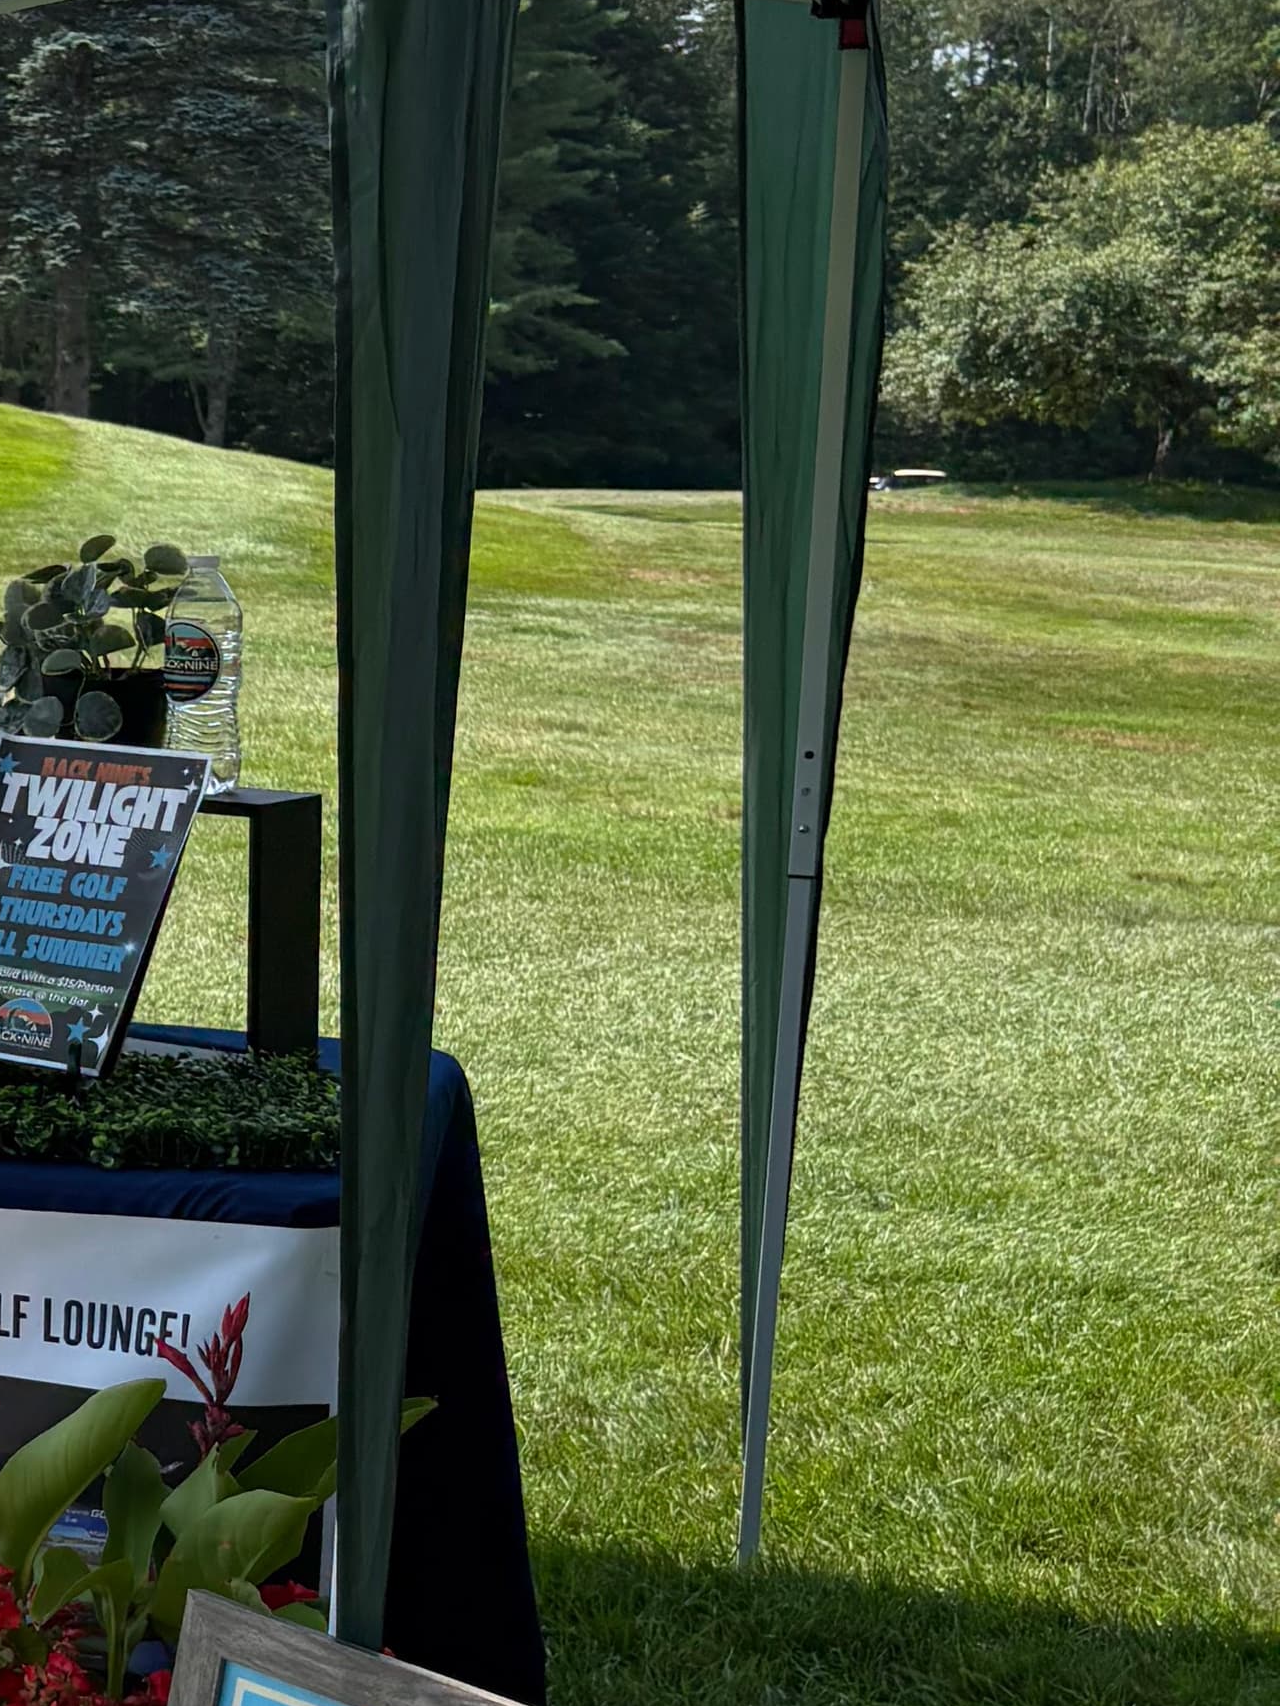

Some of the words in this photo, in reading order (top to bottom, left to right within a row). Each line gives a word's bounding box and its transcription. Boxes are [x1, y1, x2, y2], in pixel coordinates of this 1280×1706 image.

[41, 756, 92, 780] BACK
[0, 772, 189, 833] TWILIGHT
[26, 816, 133, 868] ZONE
[7, 864, 68, 894] FREE
[70, 872, 128, 902] GOLF
[22, 935, 127, 973] SUMMER
[48, 992, 67, 1003] the
[69, 996, 89, 1007] Bar
[43, 1298, 191, 1357] LOUNGE!
